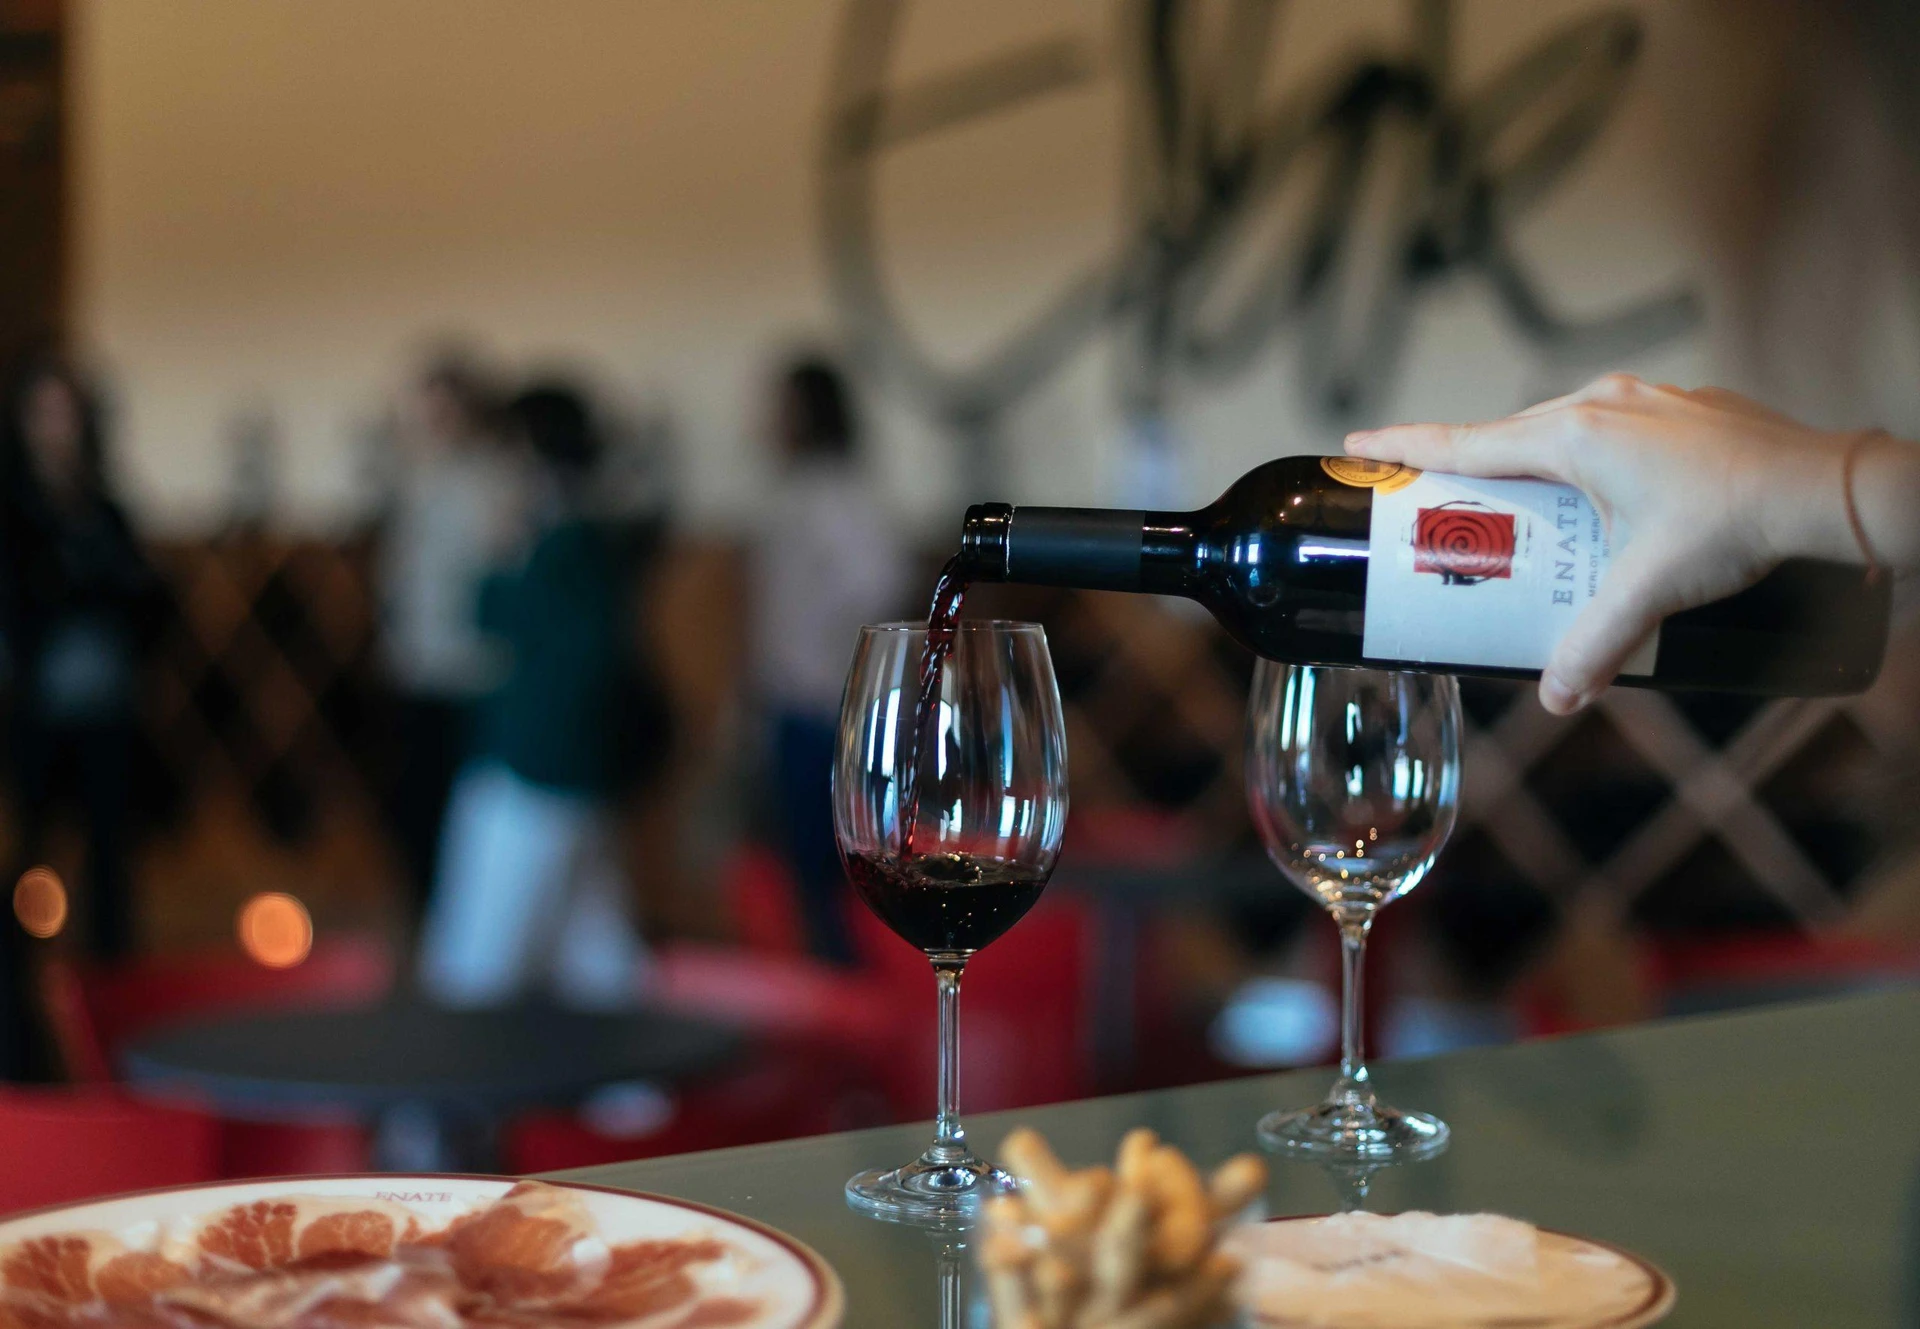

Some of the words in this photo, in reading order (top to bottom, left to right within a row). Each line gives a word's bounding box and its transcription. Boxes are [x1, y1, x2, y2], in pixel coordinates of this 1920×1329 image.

[1552, 496, 1578, 606] ENATE
[1588, 553, 1599, 597] MERLOT
[375, 1191, 453, 1202] ENATE
